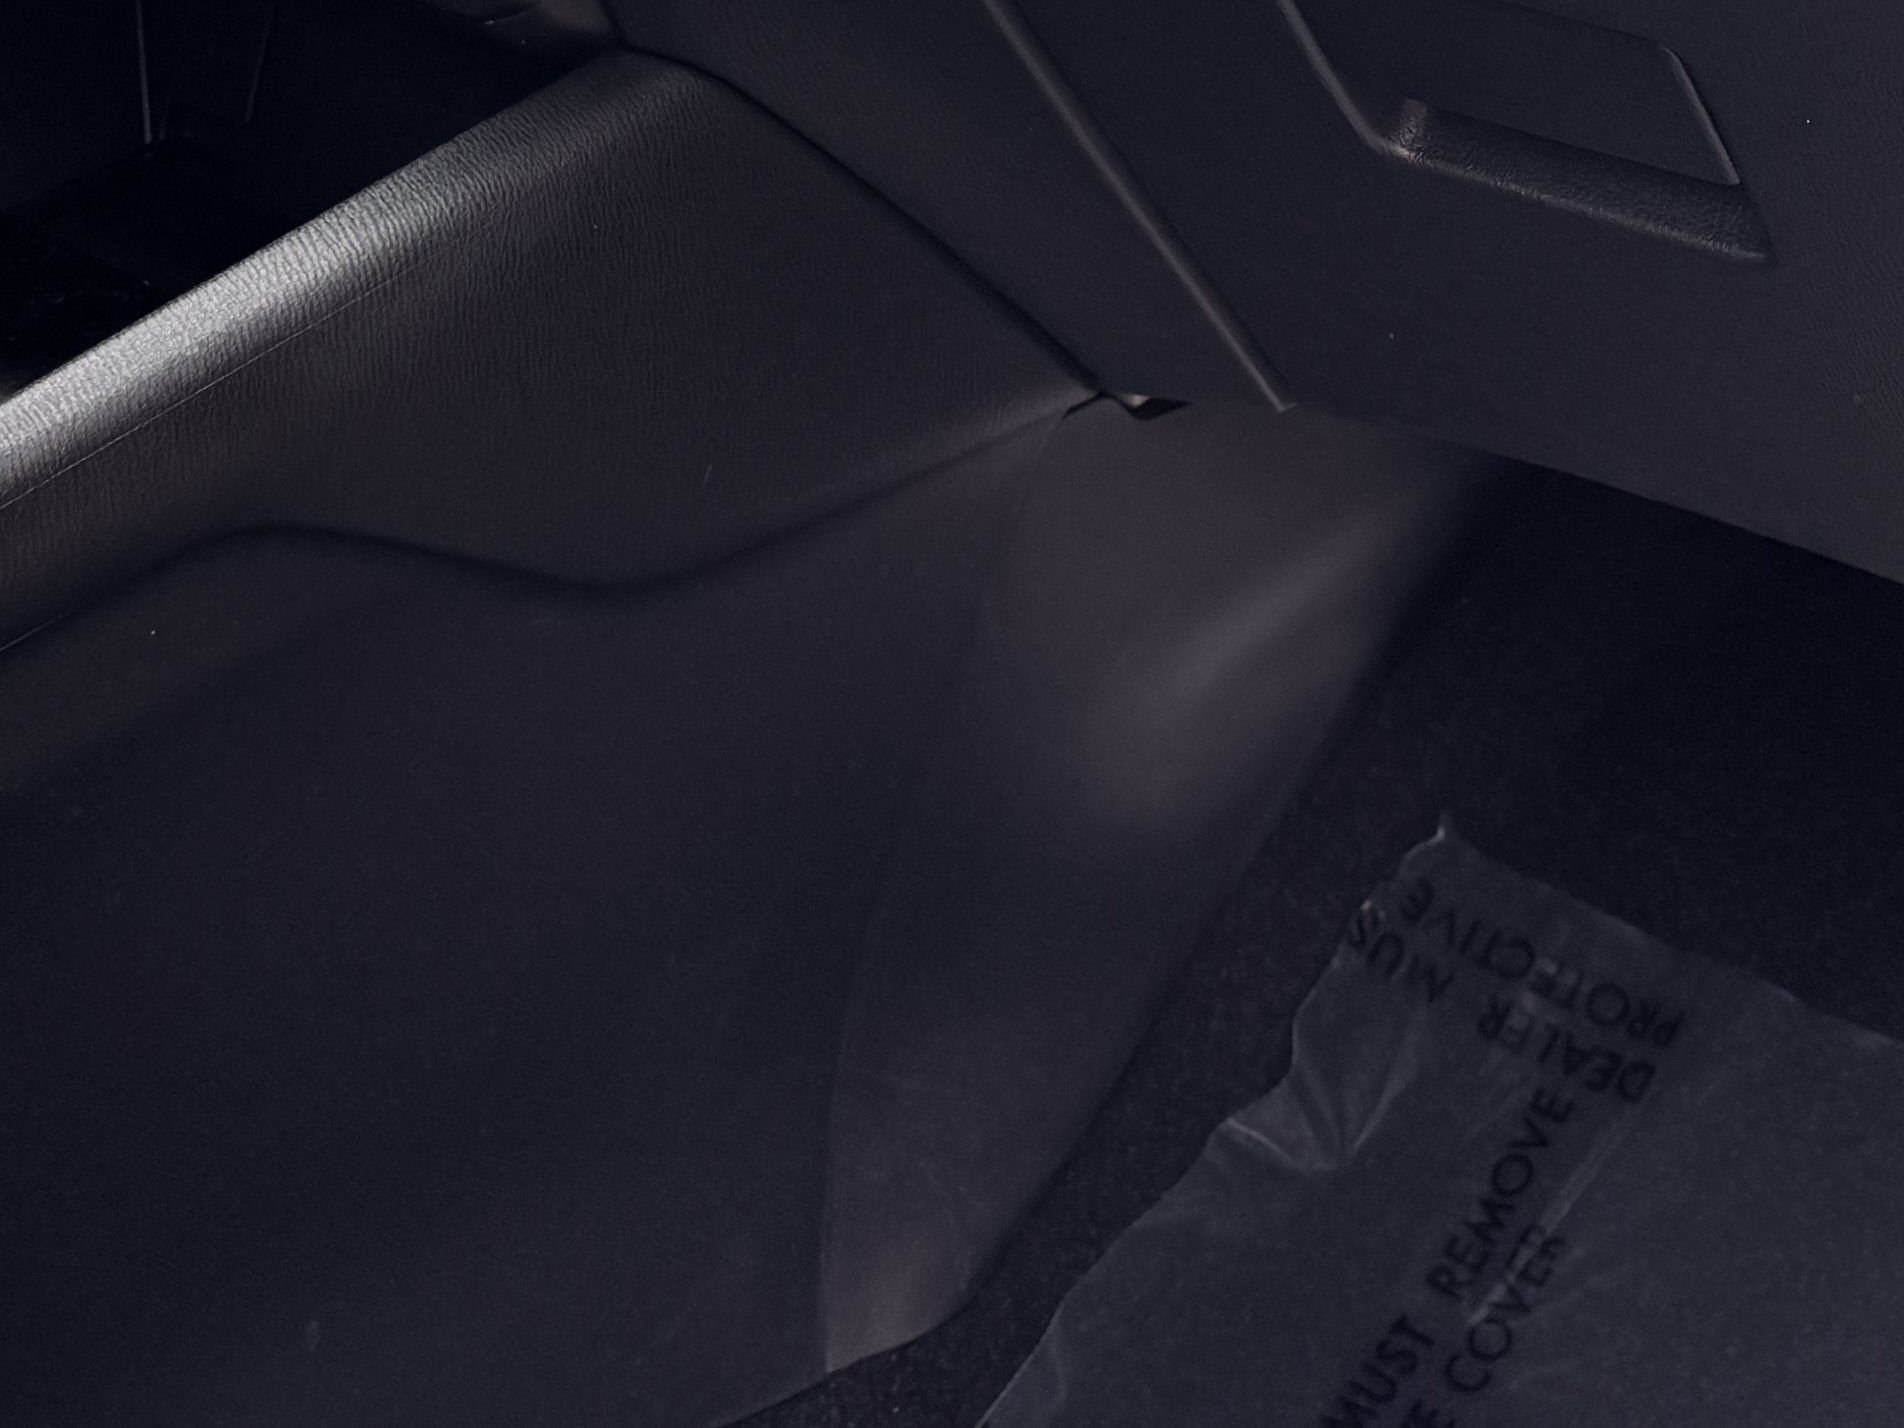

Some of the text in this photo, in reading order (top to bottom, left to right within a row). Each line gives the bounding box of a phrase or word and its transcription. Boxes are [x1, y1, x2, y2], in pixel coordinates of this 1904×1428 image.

[1475, 992, 1657, 1105] DEALER
[1425, 1089, 1576, 1302] REMOVE
[1446, 1224, 1568, 1394] COVER
